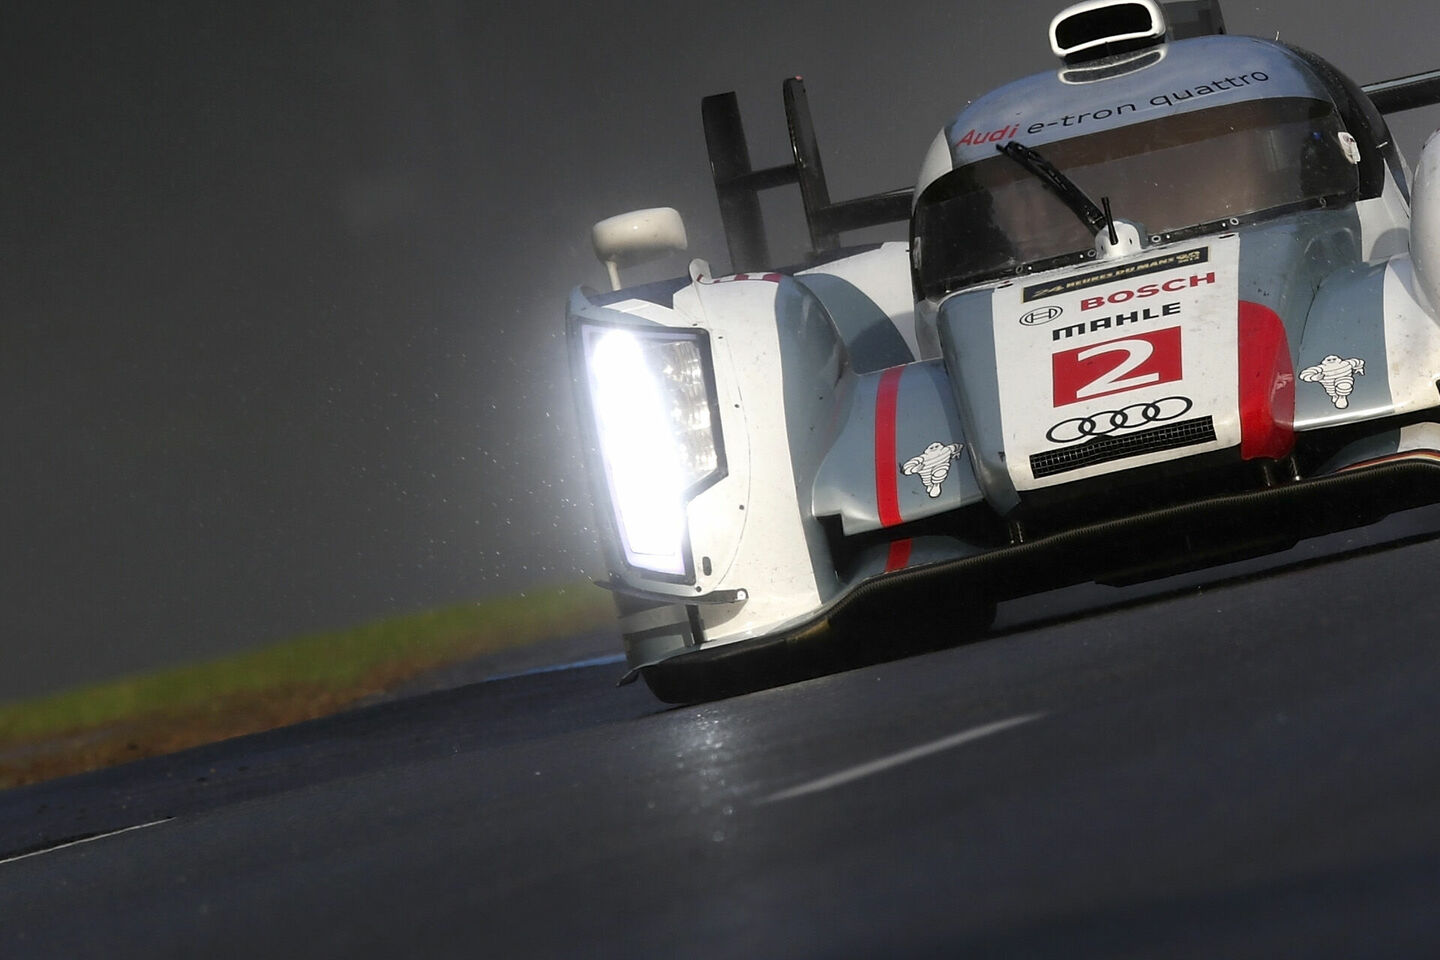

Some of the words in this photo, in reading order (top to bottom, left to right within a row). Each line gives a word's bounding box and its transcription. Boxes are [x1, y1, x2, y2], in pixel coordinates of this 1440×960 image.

[956, 124, 1020, 147] Audi
[1026, 103, 1137, 135] e-tron
[1149, 71, 1269, 107] quattro
[1080, 271, 1216, 312] BOSCH
[1052, 302, 1181, 341] MAHLE
[1076, 339, 1160, 399] 2
